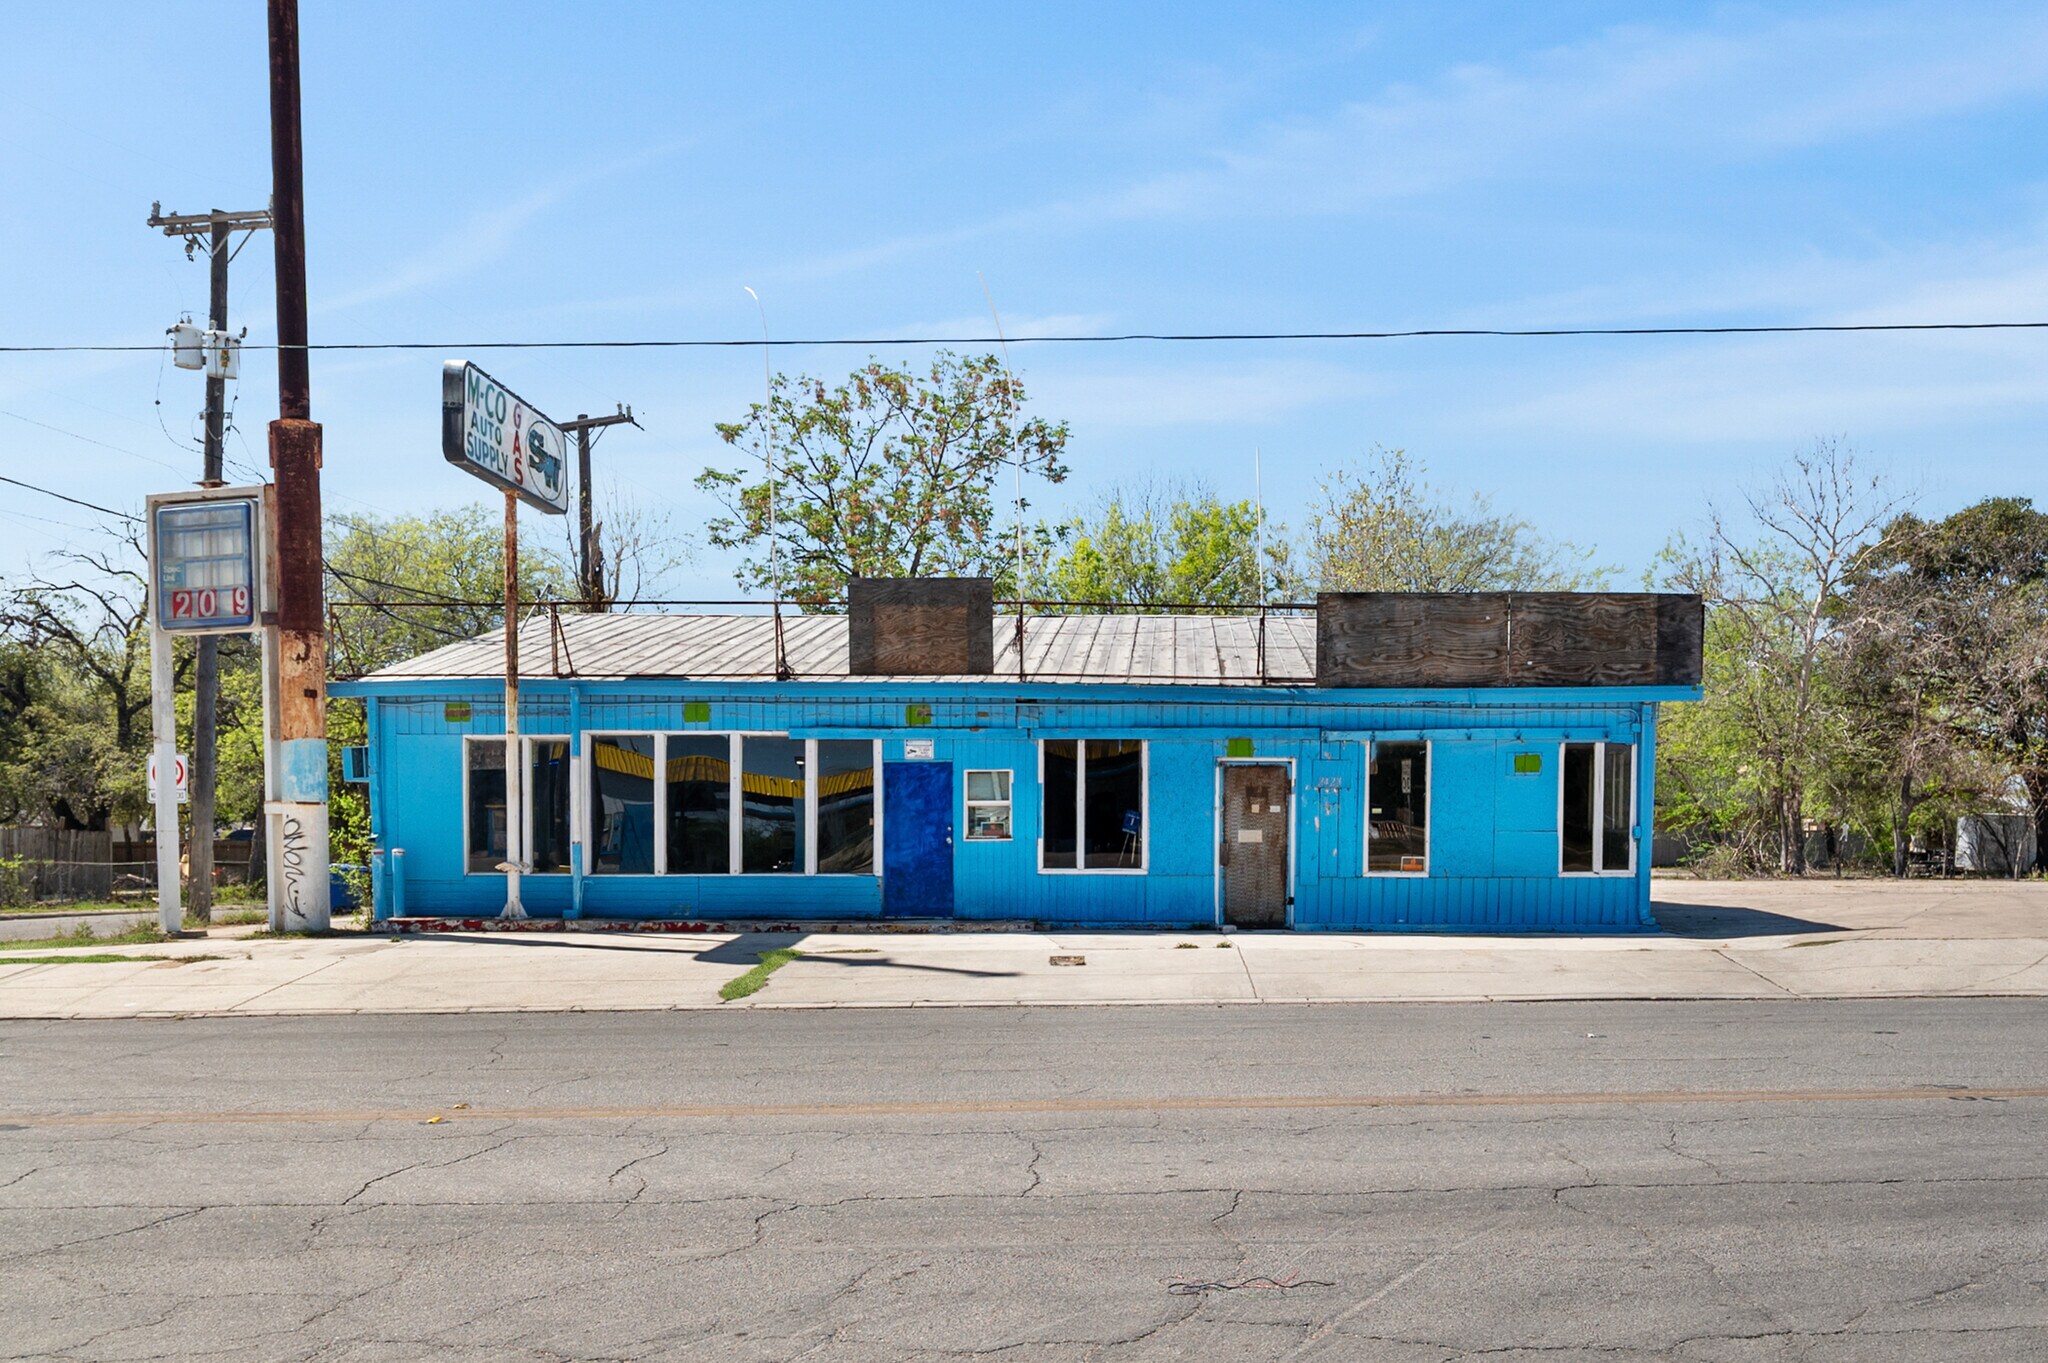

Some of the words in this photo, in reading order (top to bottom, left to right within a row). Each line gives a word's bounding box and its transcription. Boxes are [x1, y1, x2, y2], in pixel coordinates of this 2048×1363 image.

[467, 368, 507, 425] M-CO
[466, 431, 508, 476] SUPPLY
[471, 411, 503, 446] AUTO
[513, 402, 524, 486] GAS
